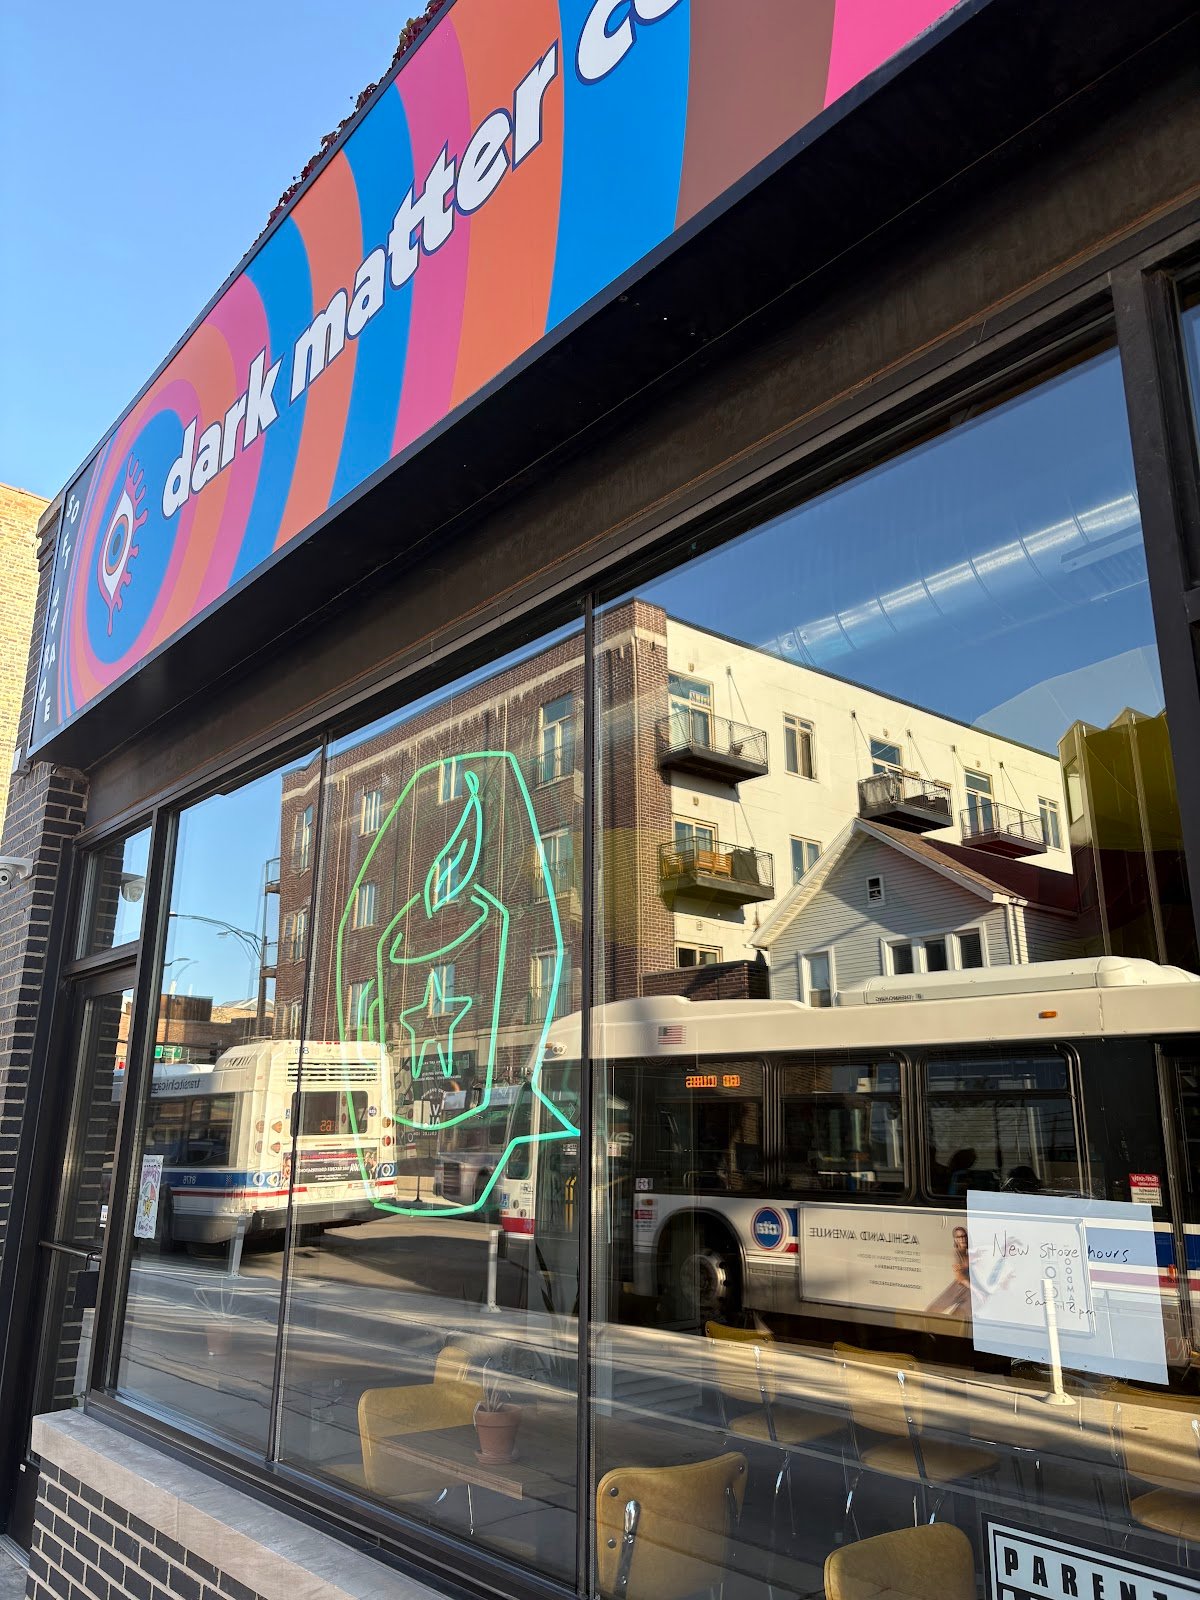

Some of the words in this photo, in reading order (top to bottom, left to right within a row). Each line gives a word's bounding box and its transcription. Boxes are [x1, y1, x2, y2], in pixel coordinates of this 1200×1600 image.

[162, 345, 284, 520] dark
[288, 38, 559, 406] matter
[992, 1230, 1029, 1258] New
[1039, 1243, 1080, 1259] Store
[1087, 1244, 1129, 1263] hours
